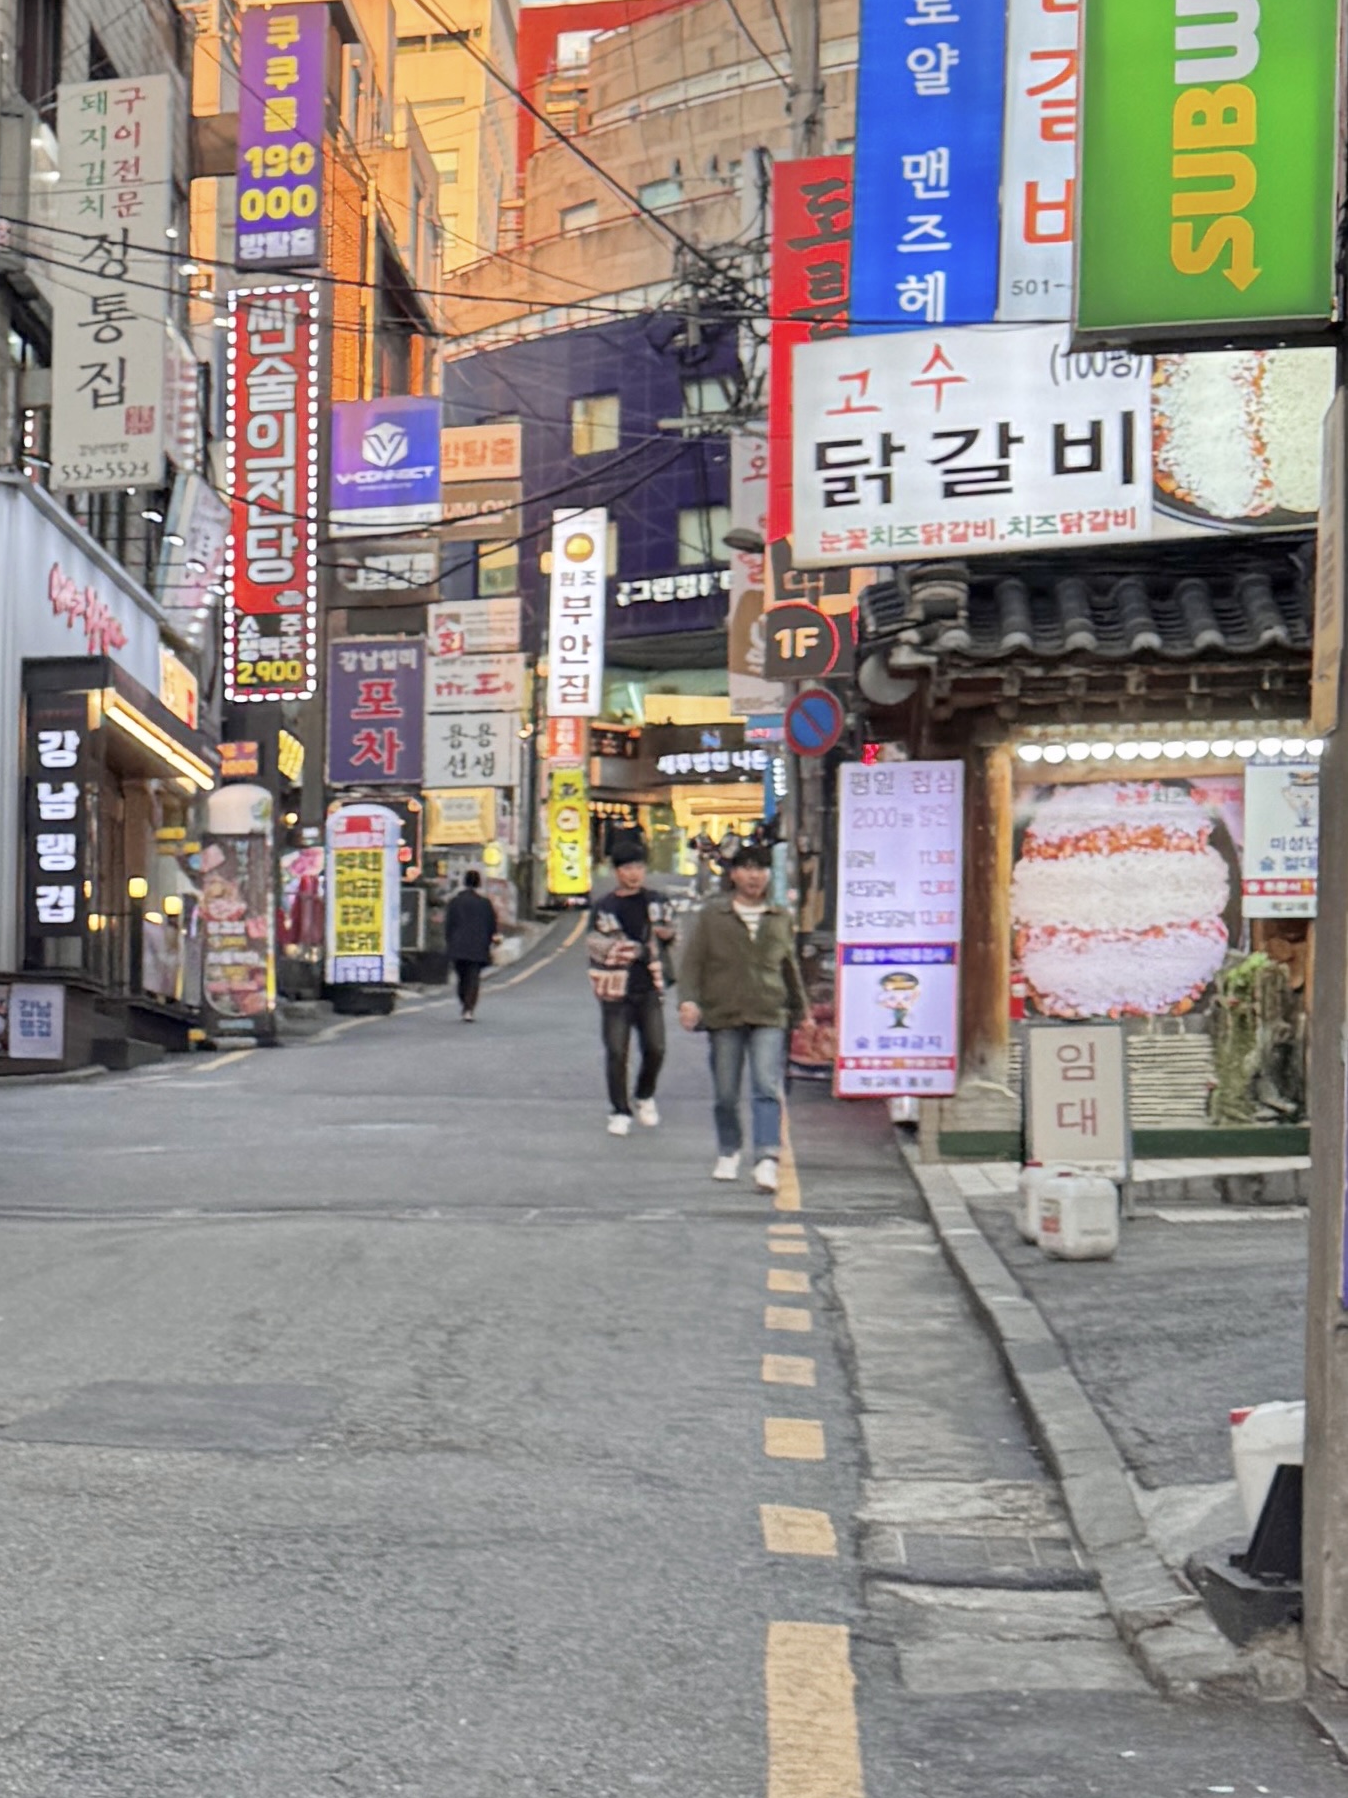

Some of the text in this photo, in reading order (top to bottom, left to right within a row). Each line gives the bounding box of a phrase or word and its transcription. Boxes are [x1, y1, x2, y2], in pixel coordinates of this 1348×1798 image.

[80, 92, 109, 220] 돼지김치
[113, 87, 146, 217] 구이전문
[245, 142, 315, 179] 190
[240, 185, 316, 222] 000
[77, 231, 137, 409] 정통집
[814, 411, 1138, 508] 닭갈비
[558, 595, 593, 703] 부안집
[774, 627, 819, 659] 1F
[350, 678, 404, 775] 포차
[1057, 1043, 1098, 1137] 임대
